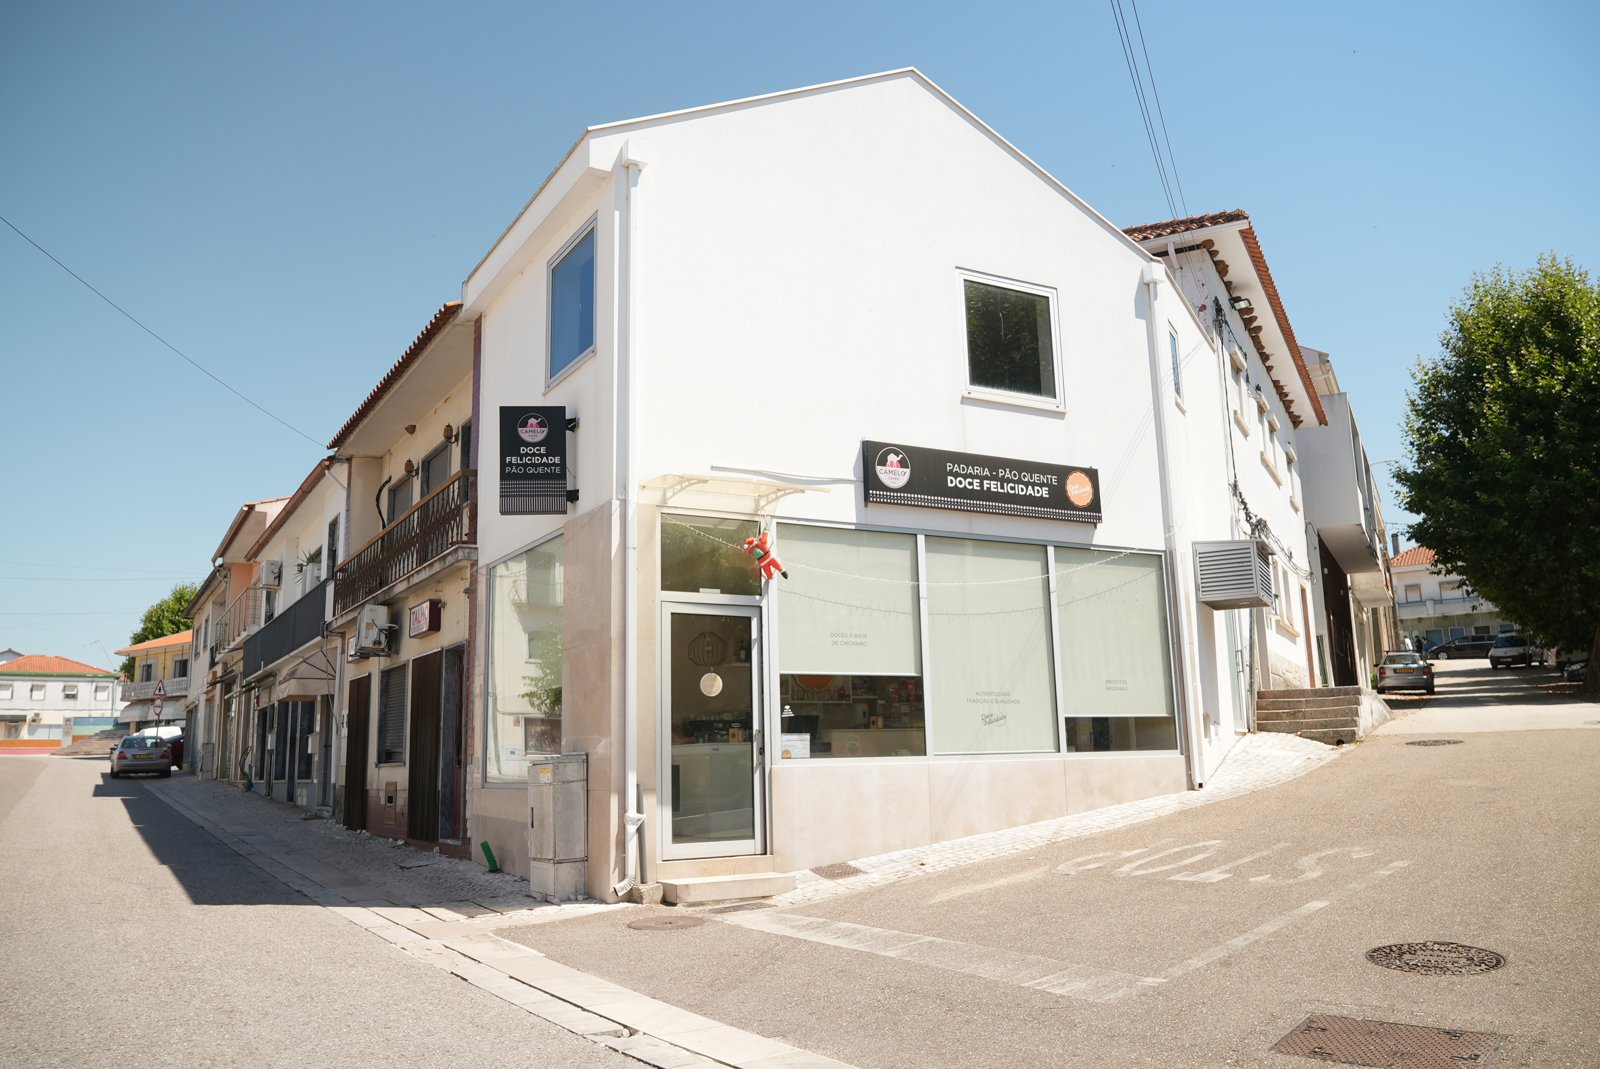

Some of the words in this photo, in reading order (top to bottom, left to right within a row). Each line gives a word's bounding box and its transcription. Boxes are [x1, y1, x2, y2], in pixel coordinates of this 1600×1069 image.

[520, 446, 547, 454] DOCE
[506, 456, 561, 464] FELICIDADE
[505, 465, 525, 474] PÃO
[526, 466, 561, 474] QUENTE
[946, 462, 991, 477] PADARIA
[998, 467, 1019, 481] PÃO
[1021, 471, 1058, 486] QUENTE
[947, 476, 981, 490] DOCE
[983, 479, 1050, 498] FELICIDADE
